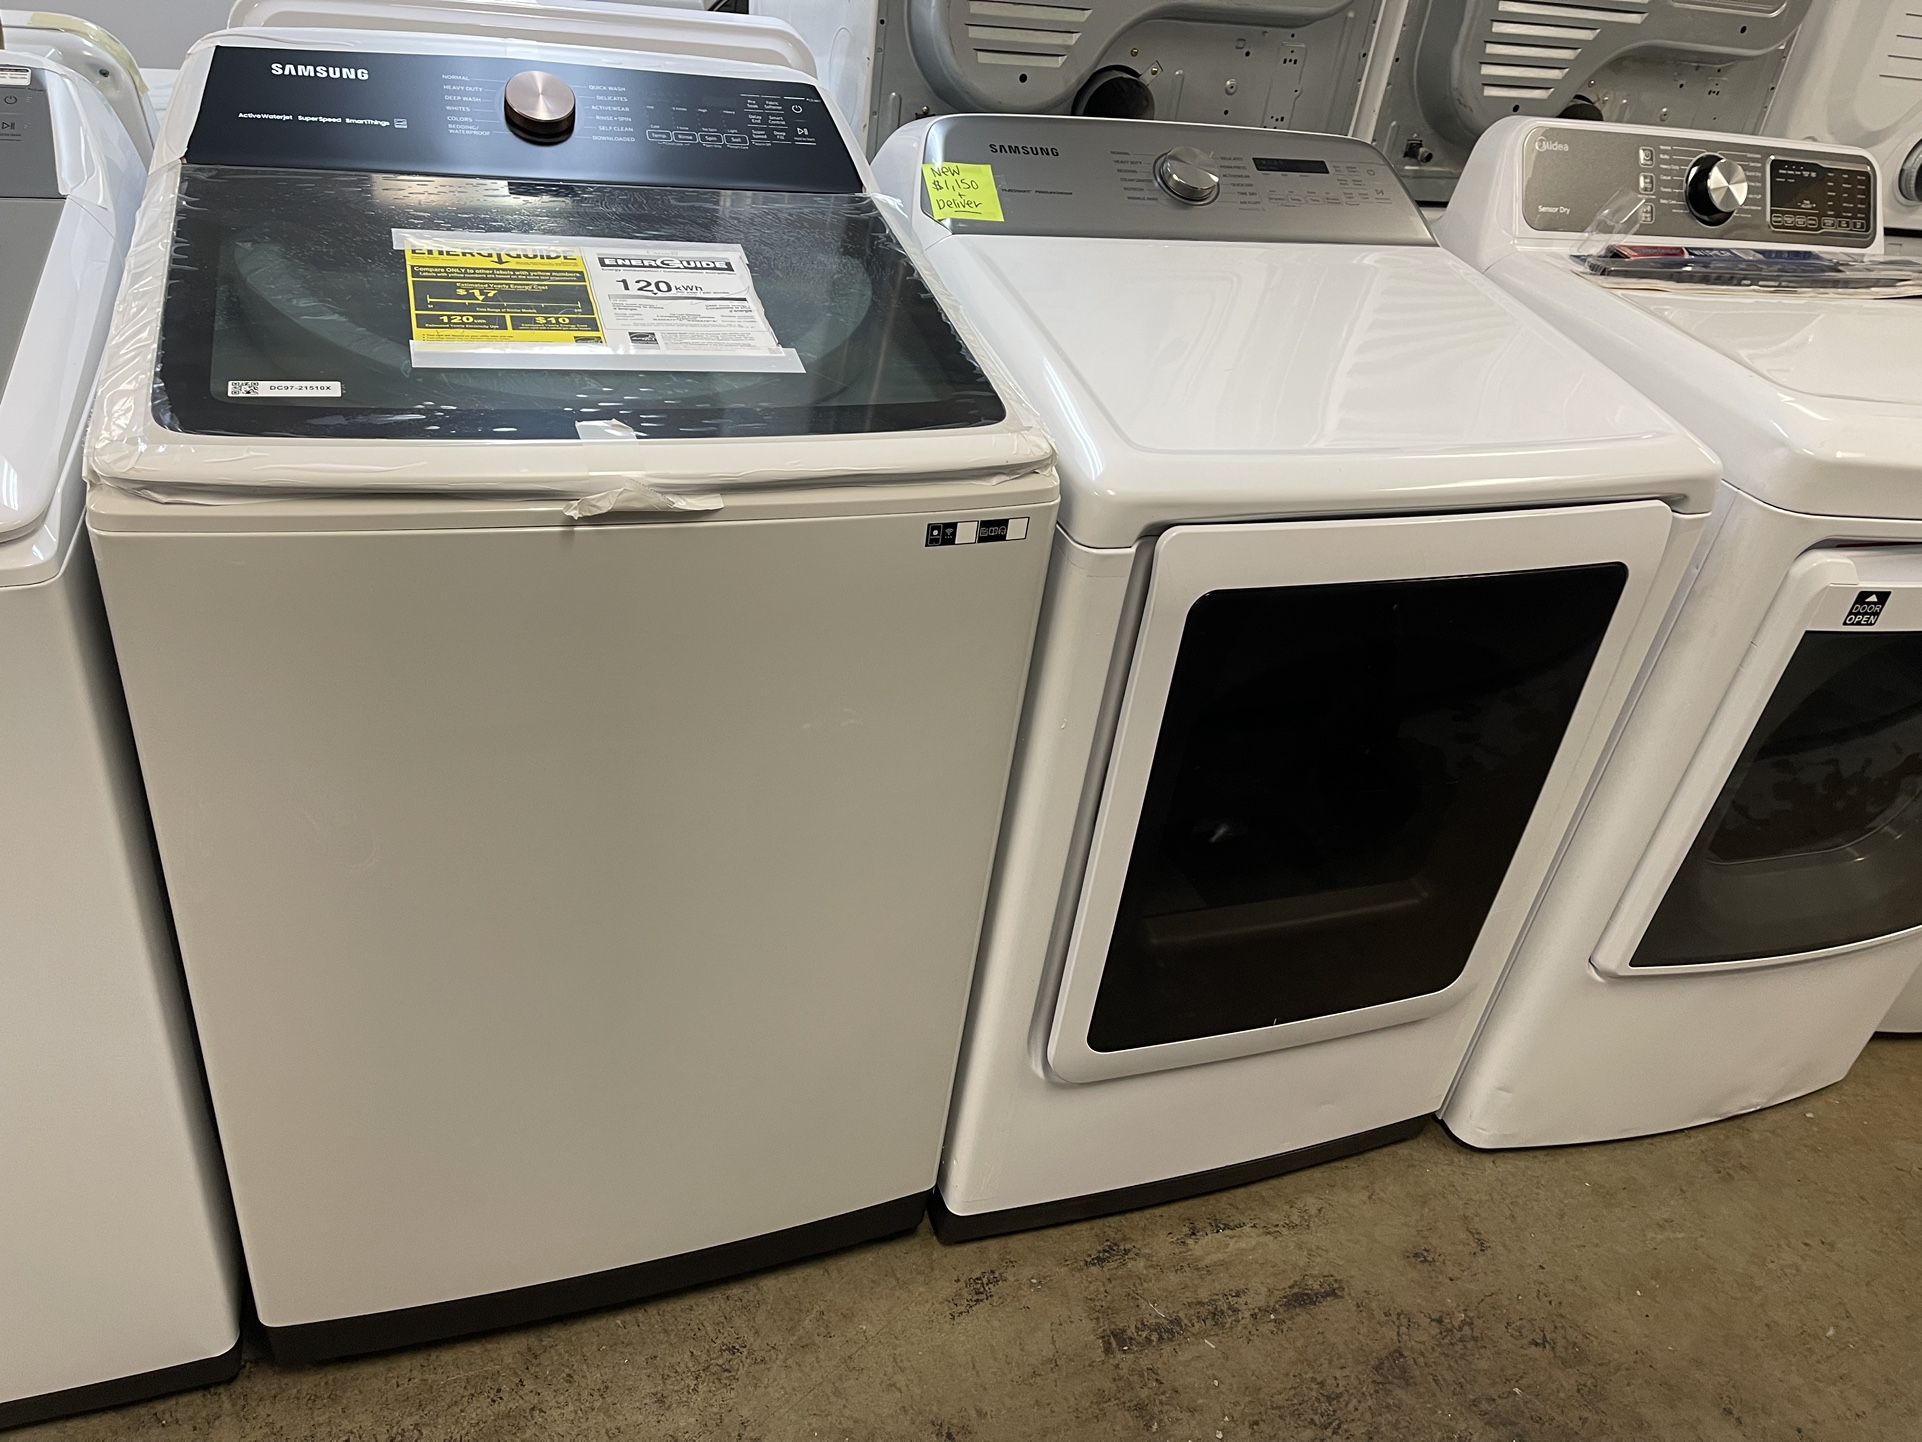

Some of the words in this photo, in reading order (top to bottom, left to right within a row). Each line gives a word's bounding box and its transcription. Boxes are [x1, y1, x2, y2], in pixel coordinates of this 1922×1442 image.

[271, 63, 369, 80] SAMSUNG
[345, 117, 390, 127] SmartThings
[1535, 136, 1569, 151] Midea
[989, 143, 1060, 157] SAMSUNG
[931, 165, 960, 178] New
[931, 178, 979, 192] $1,150
[936, 199, 983, 210] Deliver
[1559, 206, 1570, 215] Dry
[603, 257, 728, 269] ENERGUIDE
[616, 278, 673, 293] 120
[674, 284, 703, 292] kWh
[455, 289, 498, 297] $17
[439, 315, 474, 323] 120
[535, 316, 570, 324] $10
[1852, 604, 1881, 613] DOOR
[1845, 615, 1877, 624] OPEN
